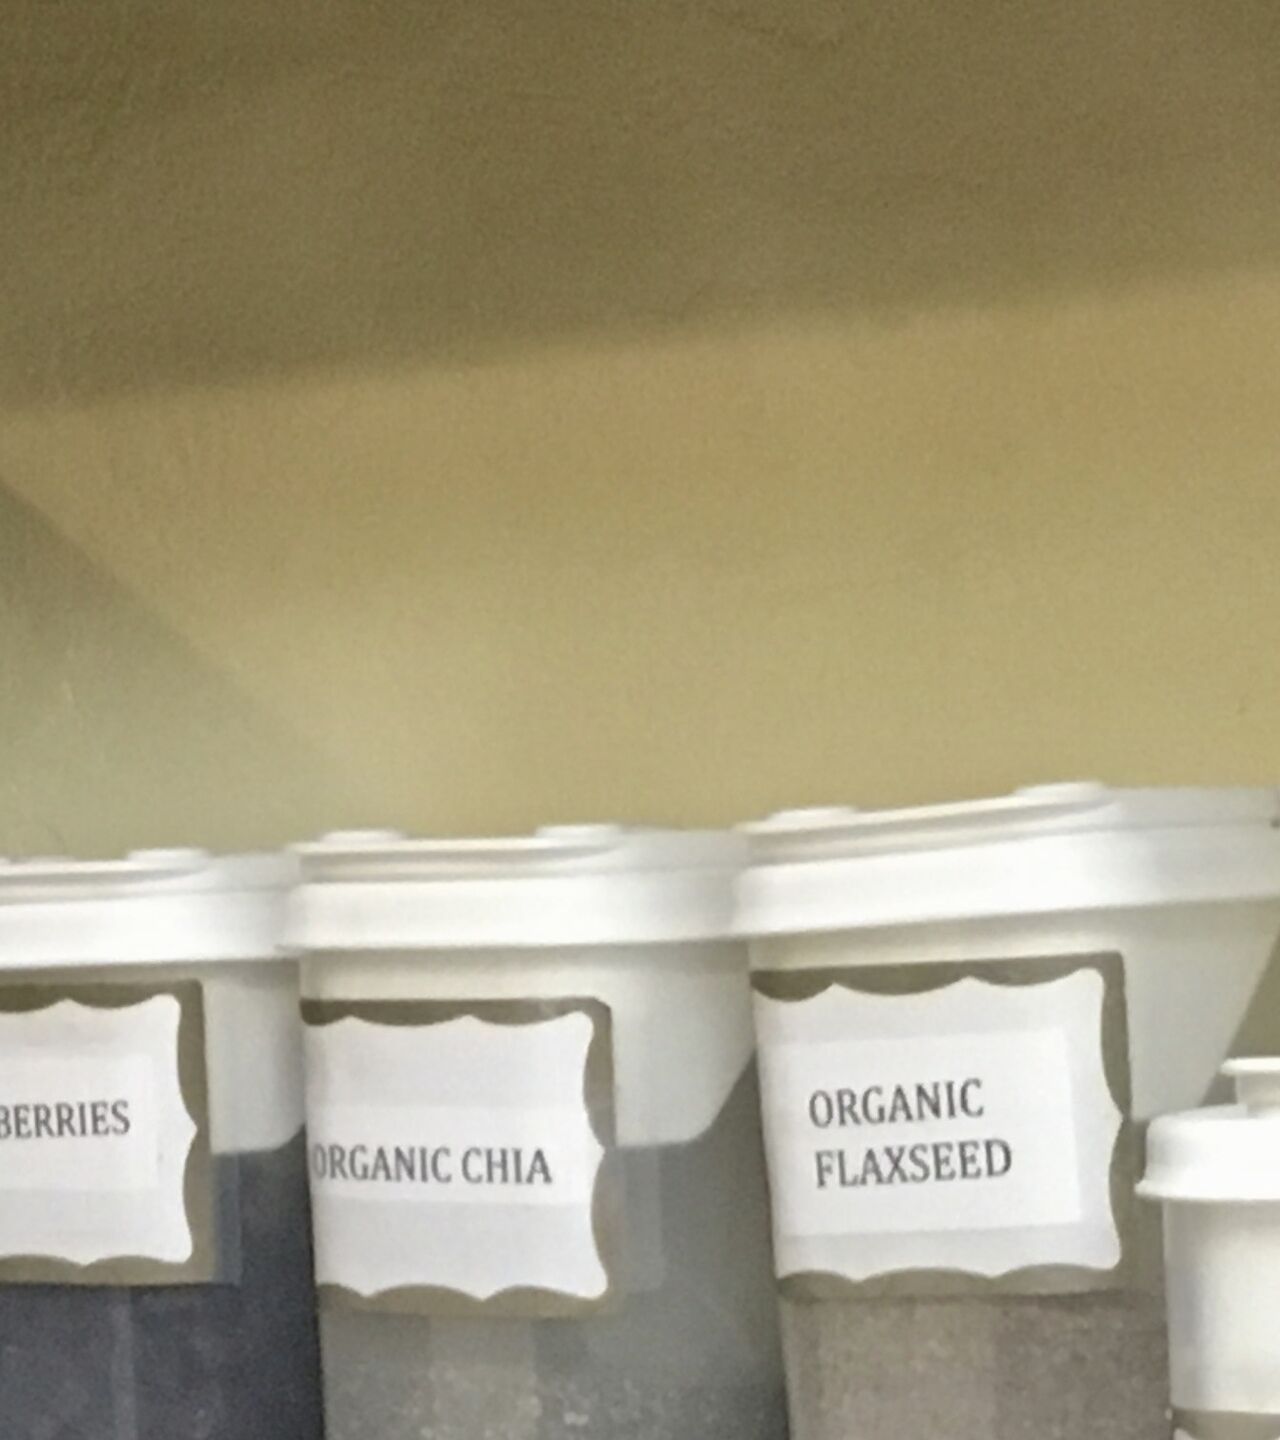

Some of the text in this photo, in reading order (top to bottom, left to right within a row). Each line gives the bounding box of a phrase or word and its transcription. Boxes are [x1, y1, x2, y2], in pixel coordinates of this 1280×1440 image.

[808, 1078, 985, 1130] ORGANIC
[313, 1143, 554, 1186] ORGANIC CHIA
[815, 1138, 1013, 1190] FLAXSEED
